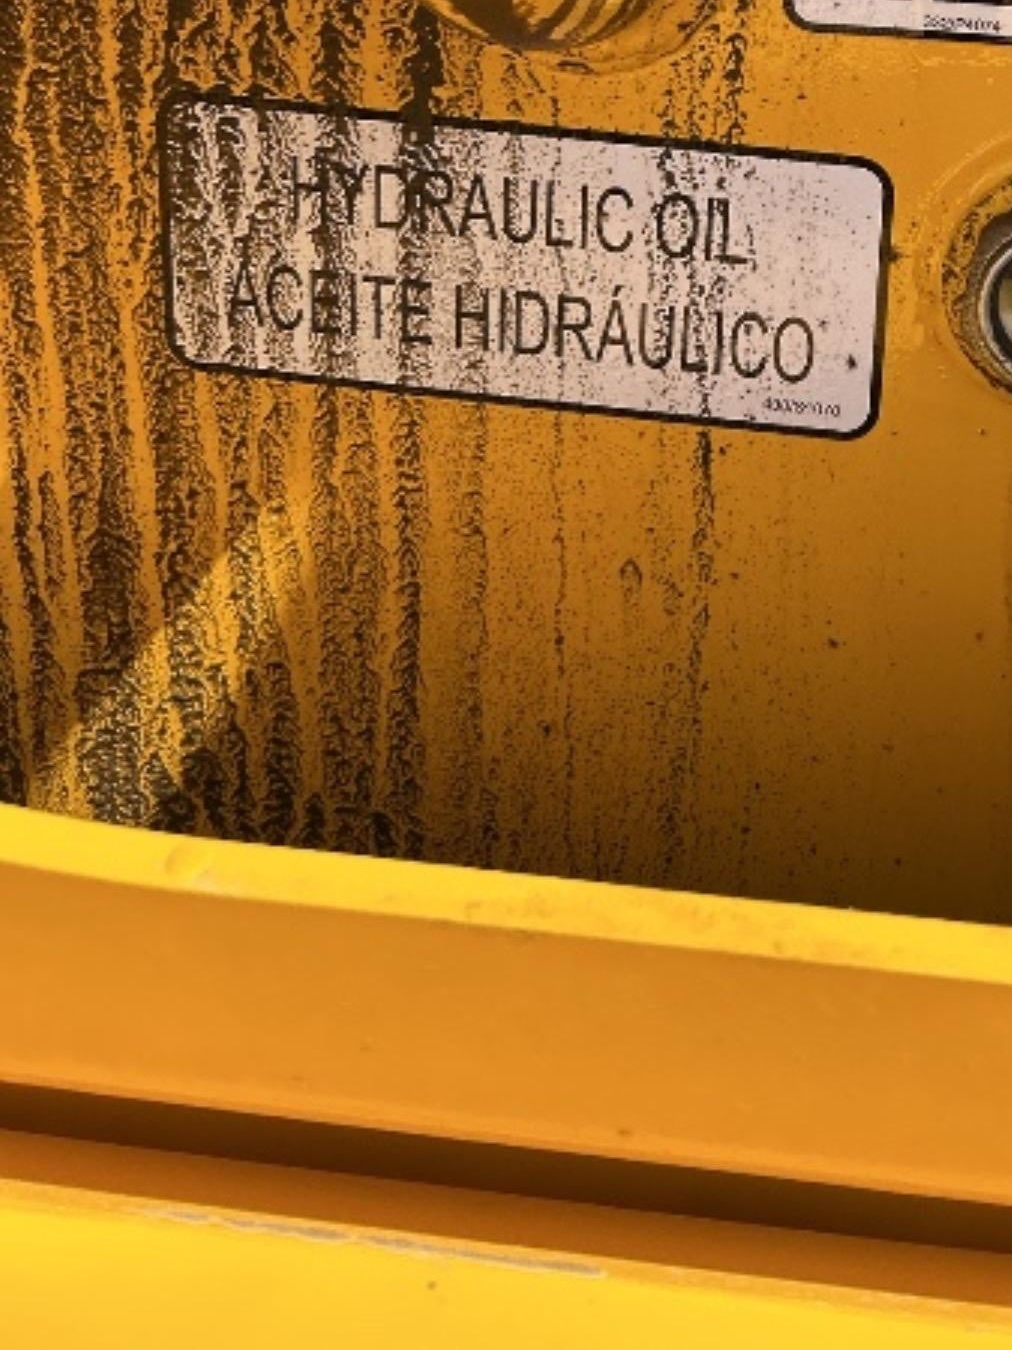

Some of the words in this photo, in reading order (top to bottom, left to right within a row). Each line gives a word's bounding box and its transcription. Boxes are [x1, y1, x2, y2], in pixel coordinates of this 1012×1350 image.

[289, 156, 635, 253] HYDRAULIC
[655, 194, 749, 266] OIL
[229, 260, 434, 346] ACEITE
[455, 286, 815, 384] HIDRÁULICO
